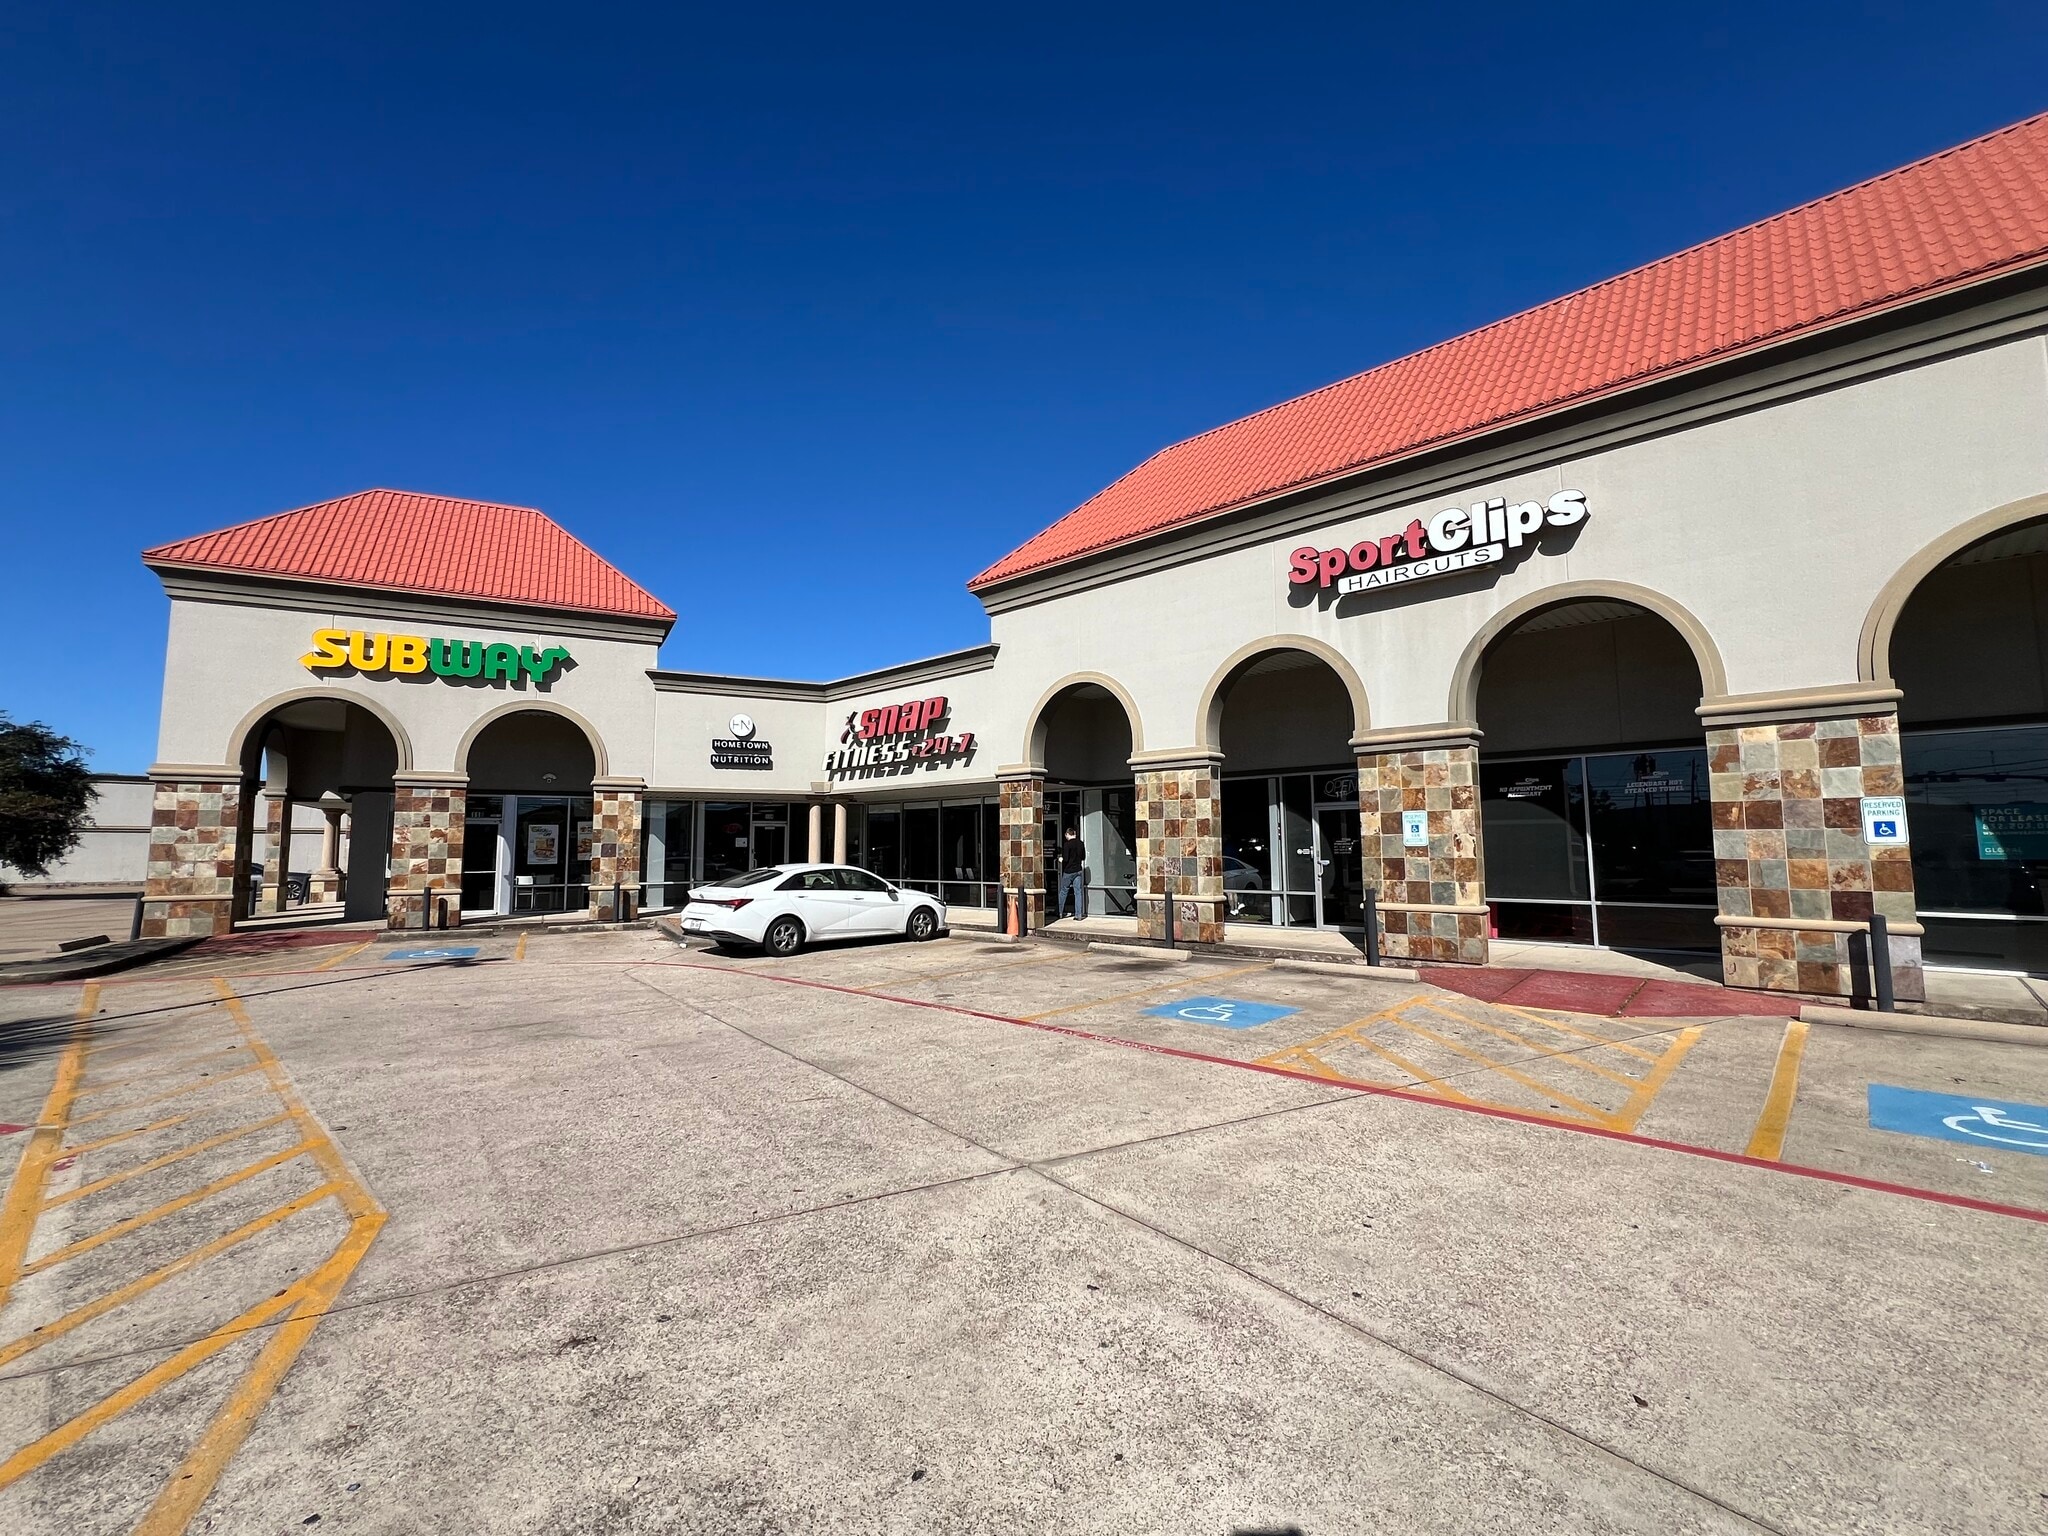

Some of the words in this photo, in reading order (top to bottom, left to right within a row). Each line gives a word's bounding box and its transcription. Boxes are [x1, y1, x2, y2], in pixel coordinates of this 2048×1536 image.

[1347, 549, 1492, 591] HAIRCUTS
[298, 628, 571, 682] SUBWAY
[714, 740, 768, 749] HOMETOWN
[712, 755, 769, 764] NUTRITION
[821, 740, 911, 771] FITNESS
[1325, 780, 1357, 793] OPEN
[1980, 807, 2021, 816] SPACE
[1981, 815, 2005, 823] FOR
